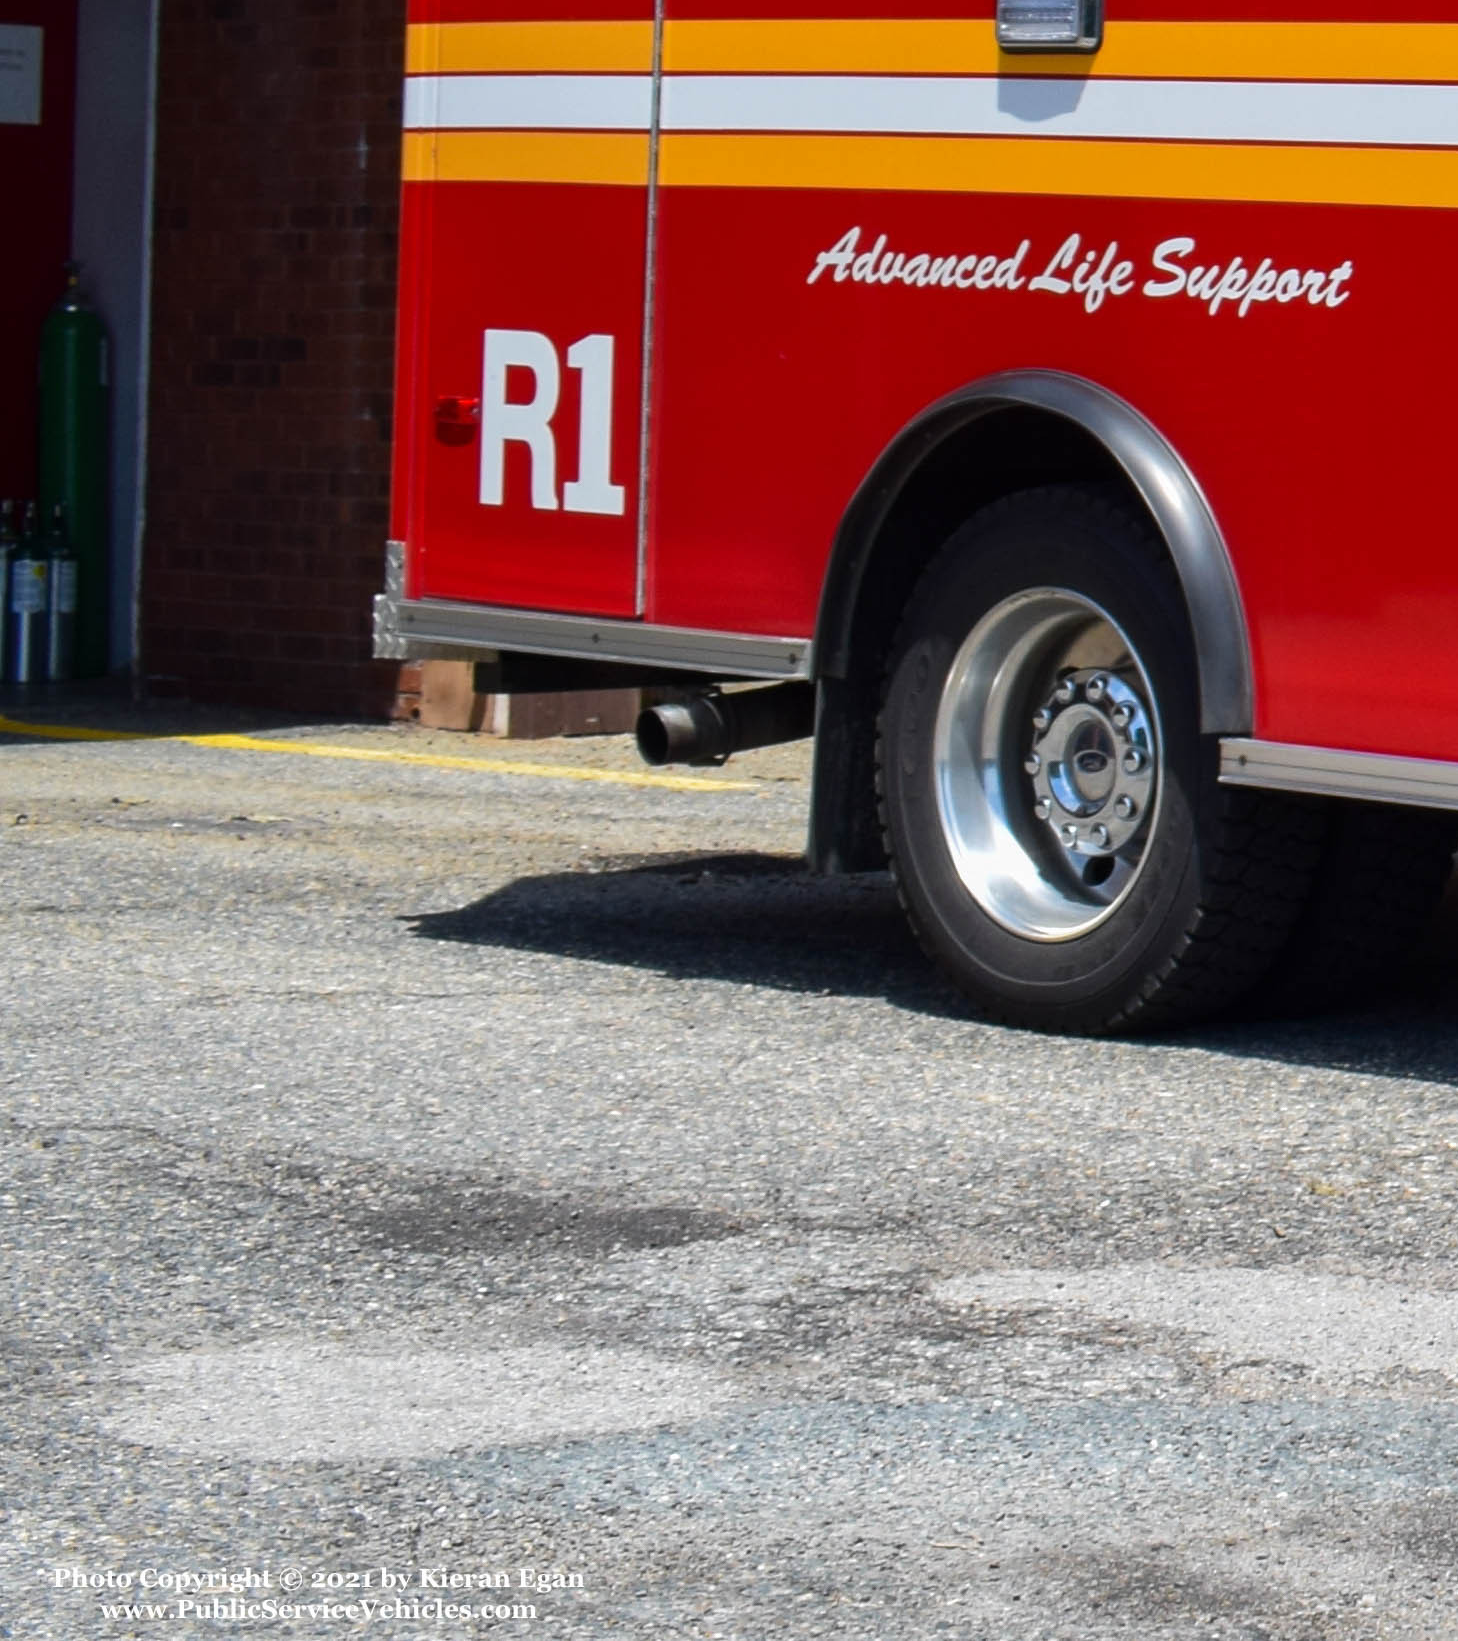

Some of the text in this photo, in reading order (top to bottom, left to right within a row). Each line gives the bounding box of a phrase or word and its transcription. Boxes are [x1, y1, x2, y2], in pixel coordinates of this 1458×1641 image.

[806, 225, 1354, 318] Advanced Life Support
[479, 328, 626, 516] R1
